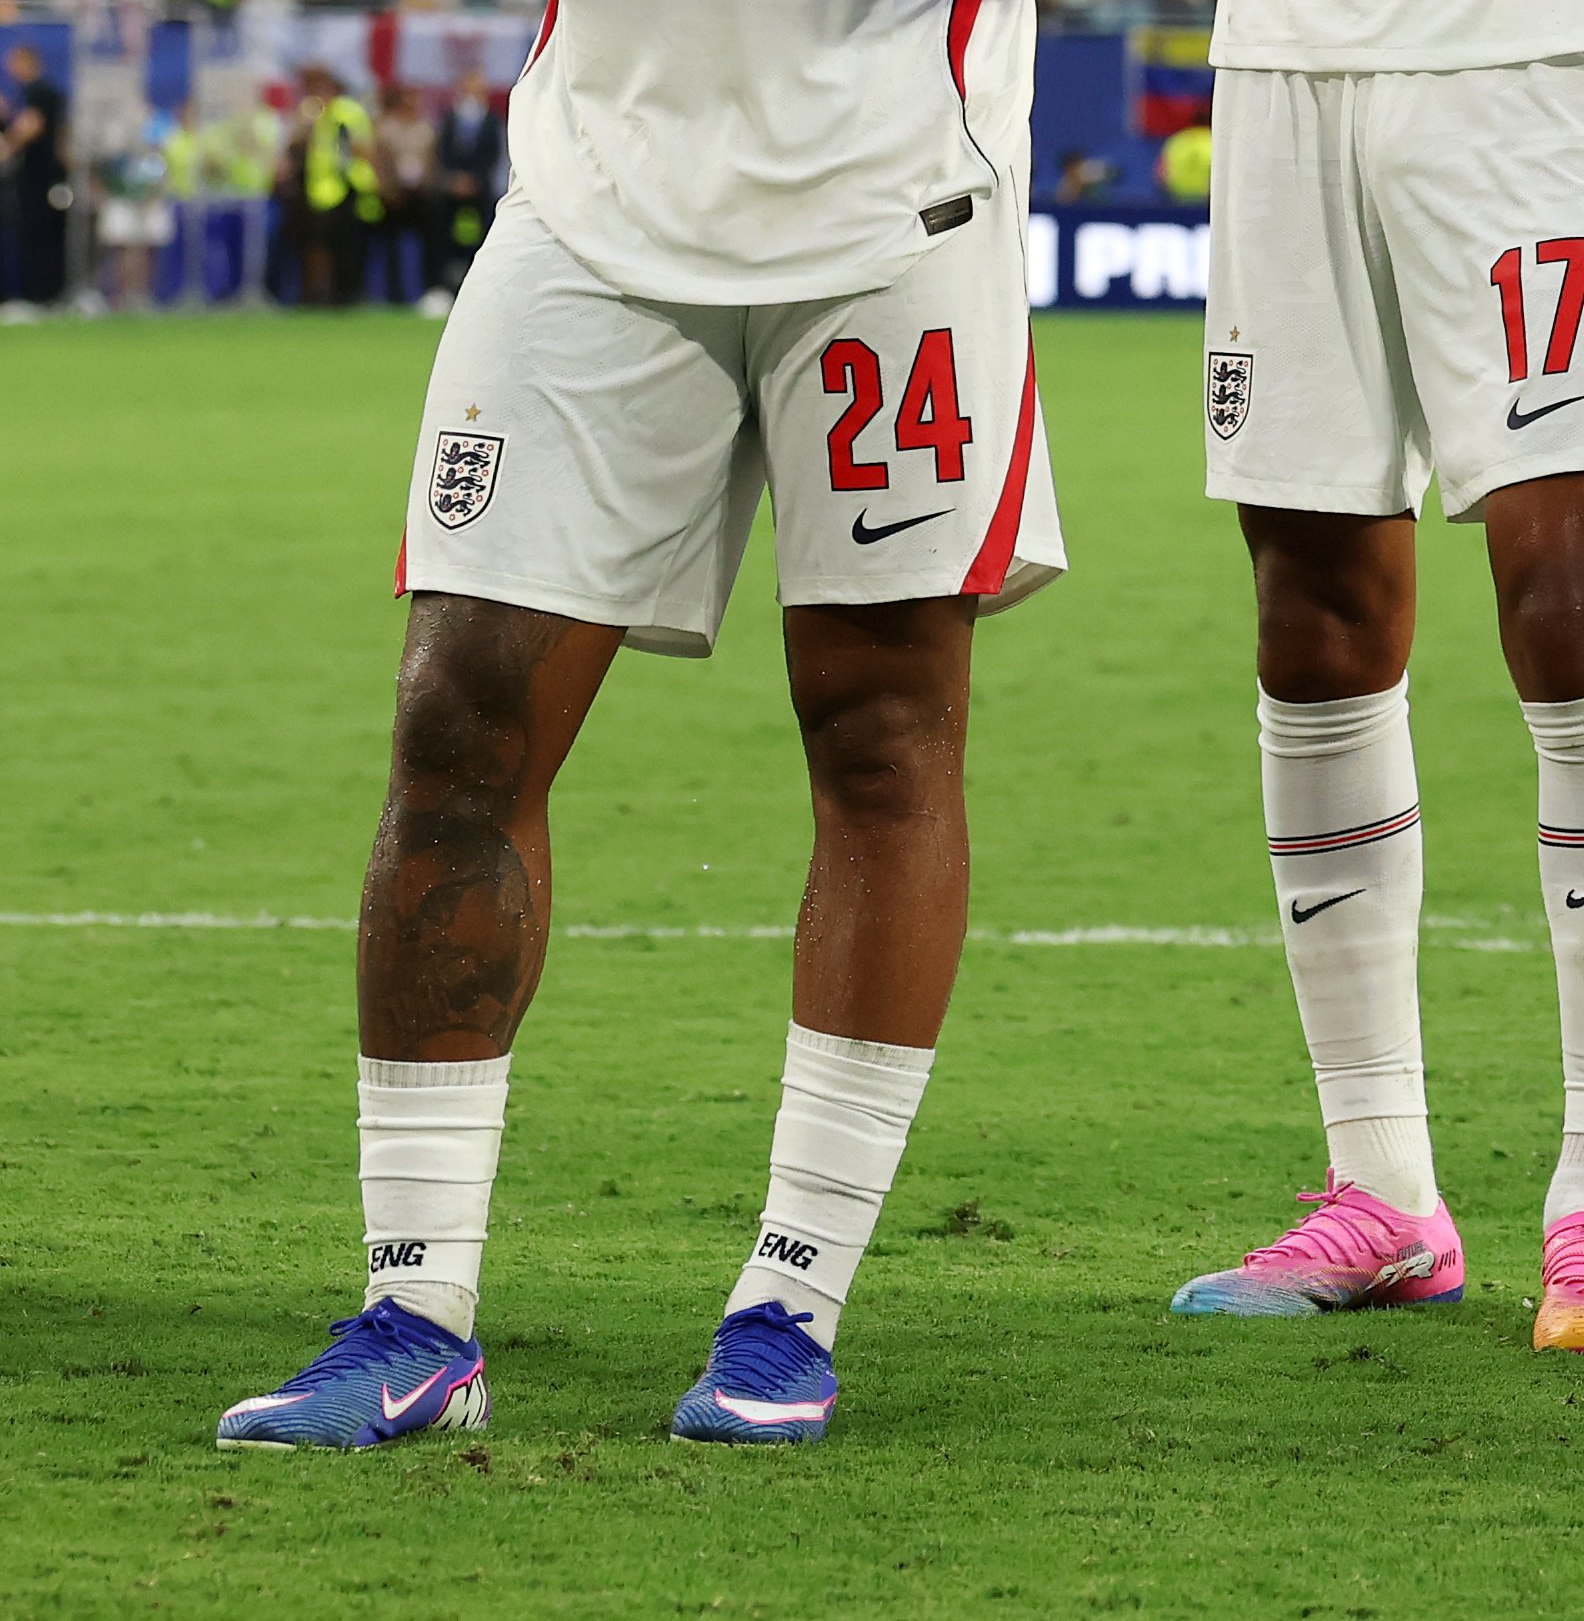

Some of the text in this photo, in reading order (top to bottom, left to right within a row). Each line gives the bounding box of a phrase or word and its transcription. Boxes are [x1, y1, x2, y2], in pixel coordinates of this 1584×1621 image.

[819, 327, 974, 492] 24
[370, 1241, 427, 1274] ENG
[758, 1231, 819, 1271] ENG
